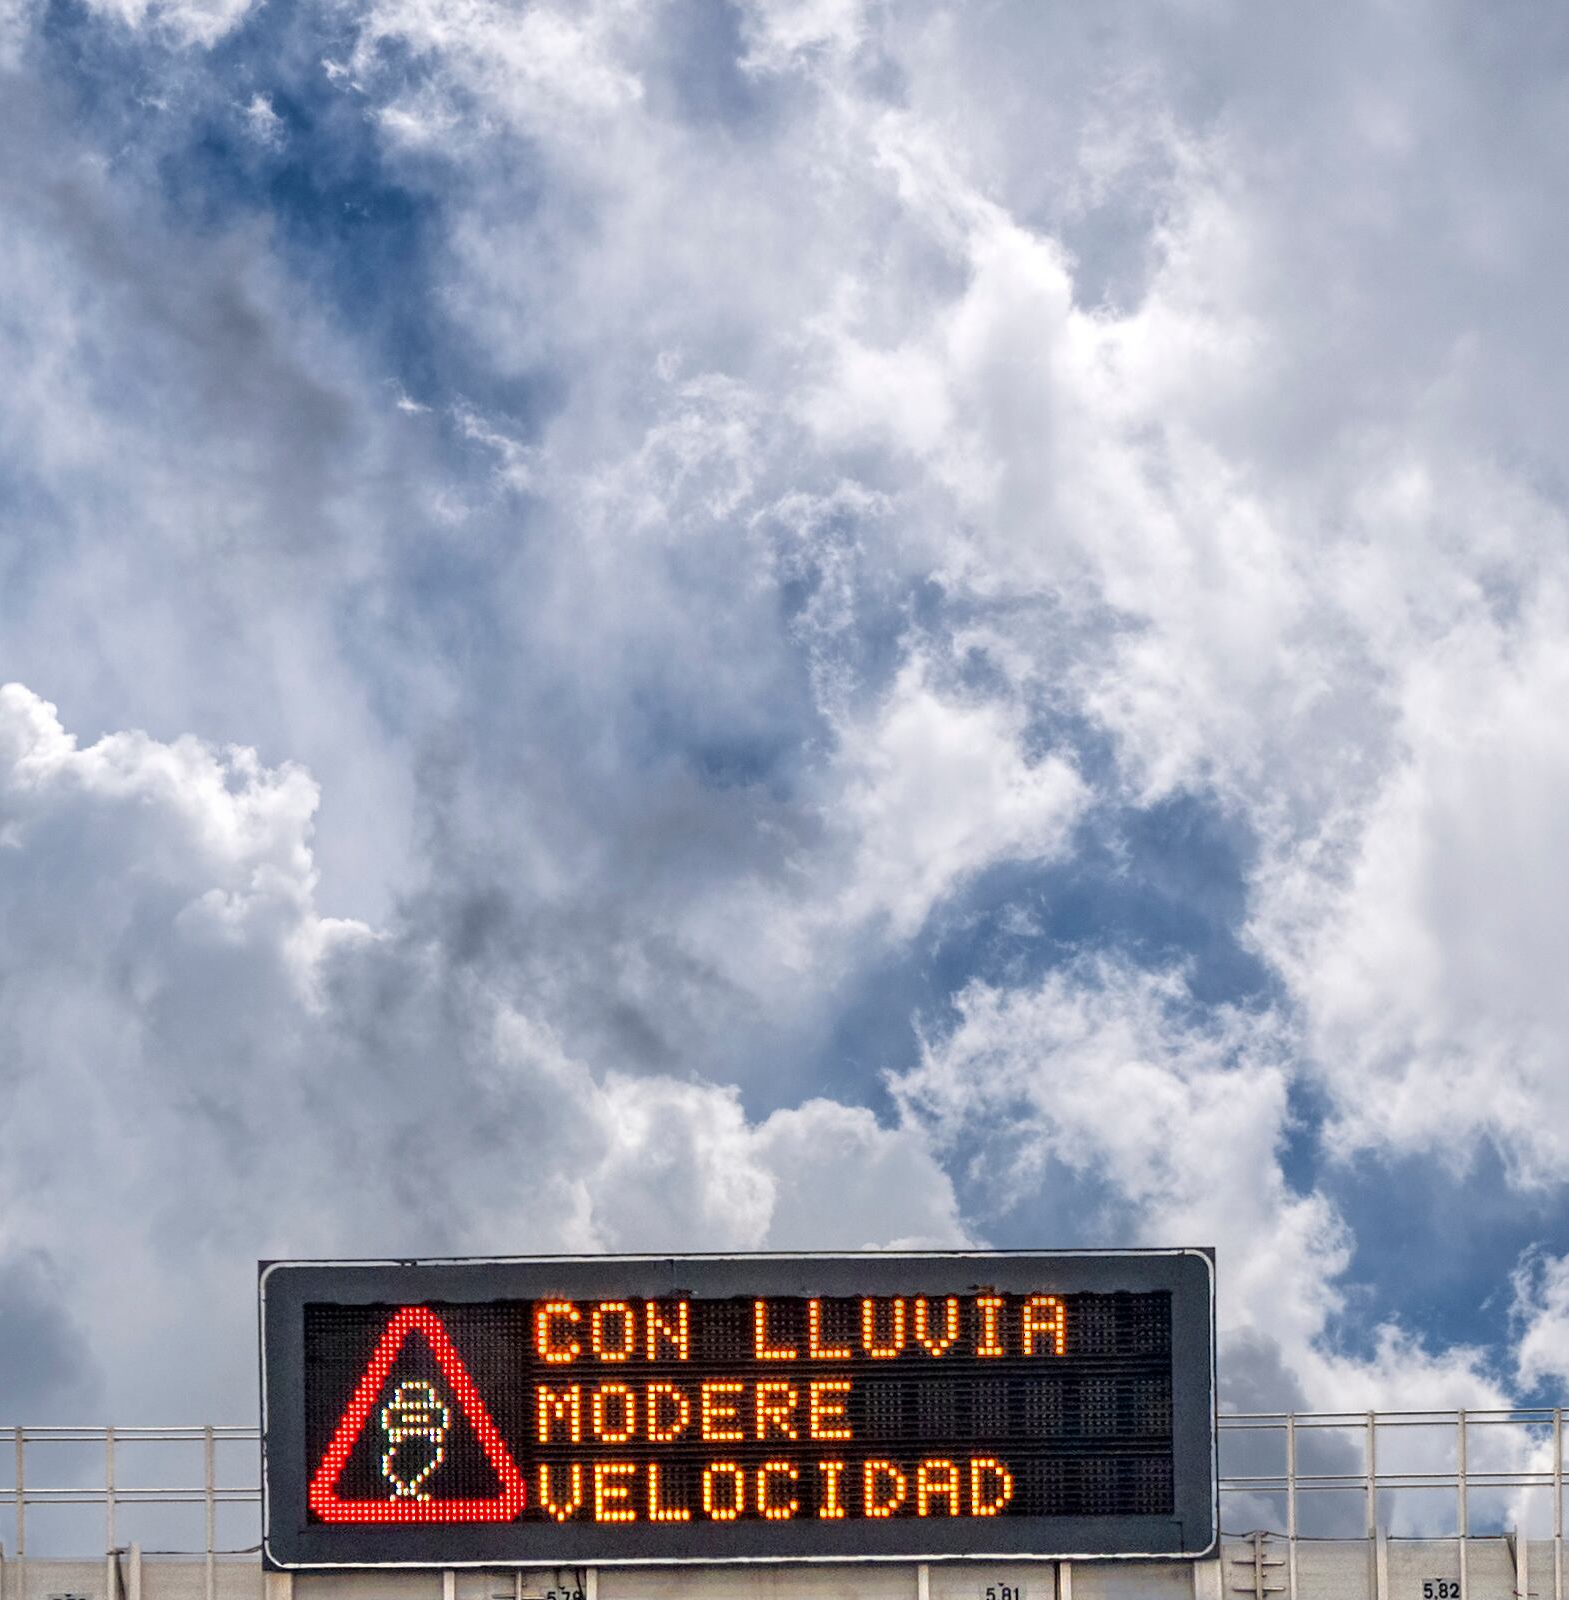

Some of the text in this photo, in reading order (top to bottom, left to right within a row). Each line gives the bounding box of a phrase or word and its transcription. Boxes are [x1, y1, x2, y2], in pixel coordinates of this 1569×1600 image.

[535, 1295, 1067, 1364] CON LLUVIA
[535, 1380, 854, 1444] MODERE
[537, 1457, 1013, 1523] VELOCIDAD
